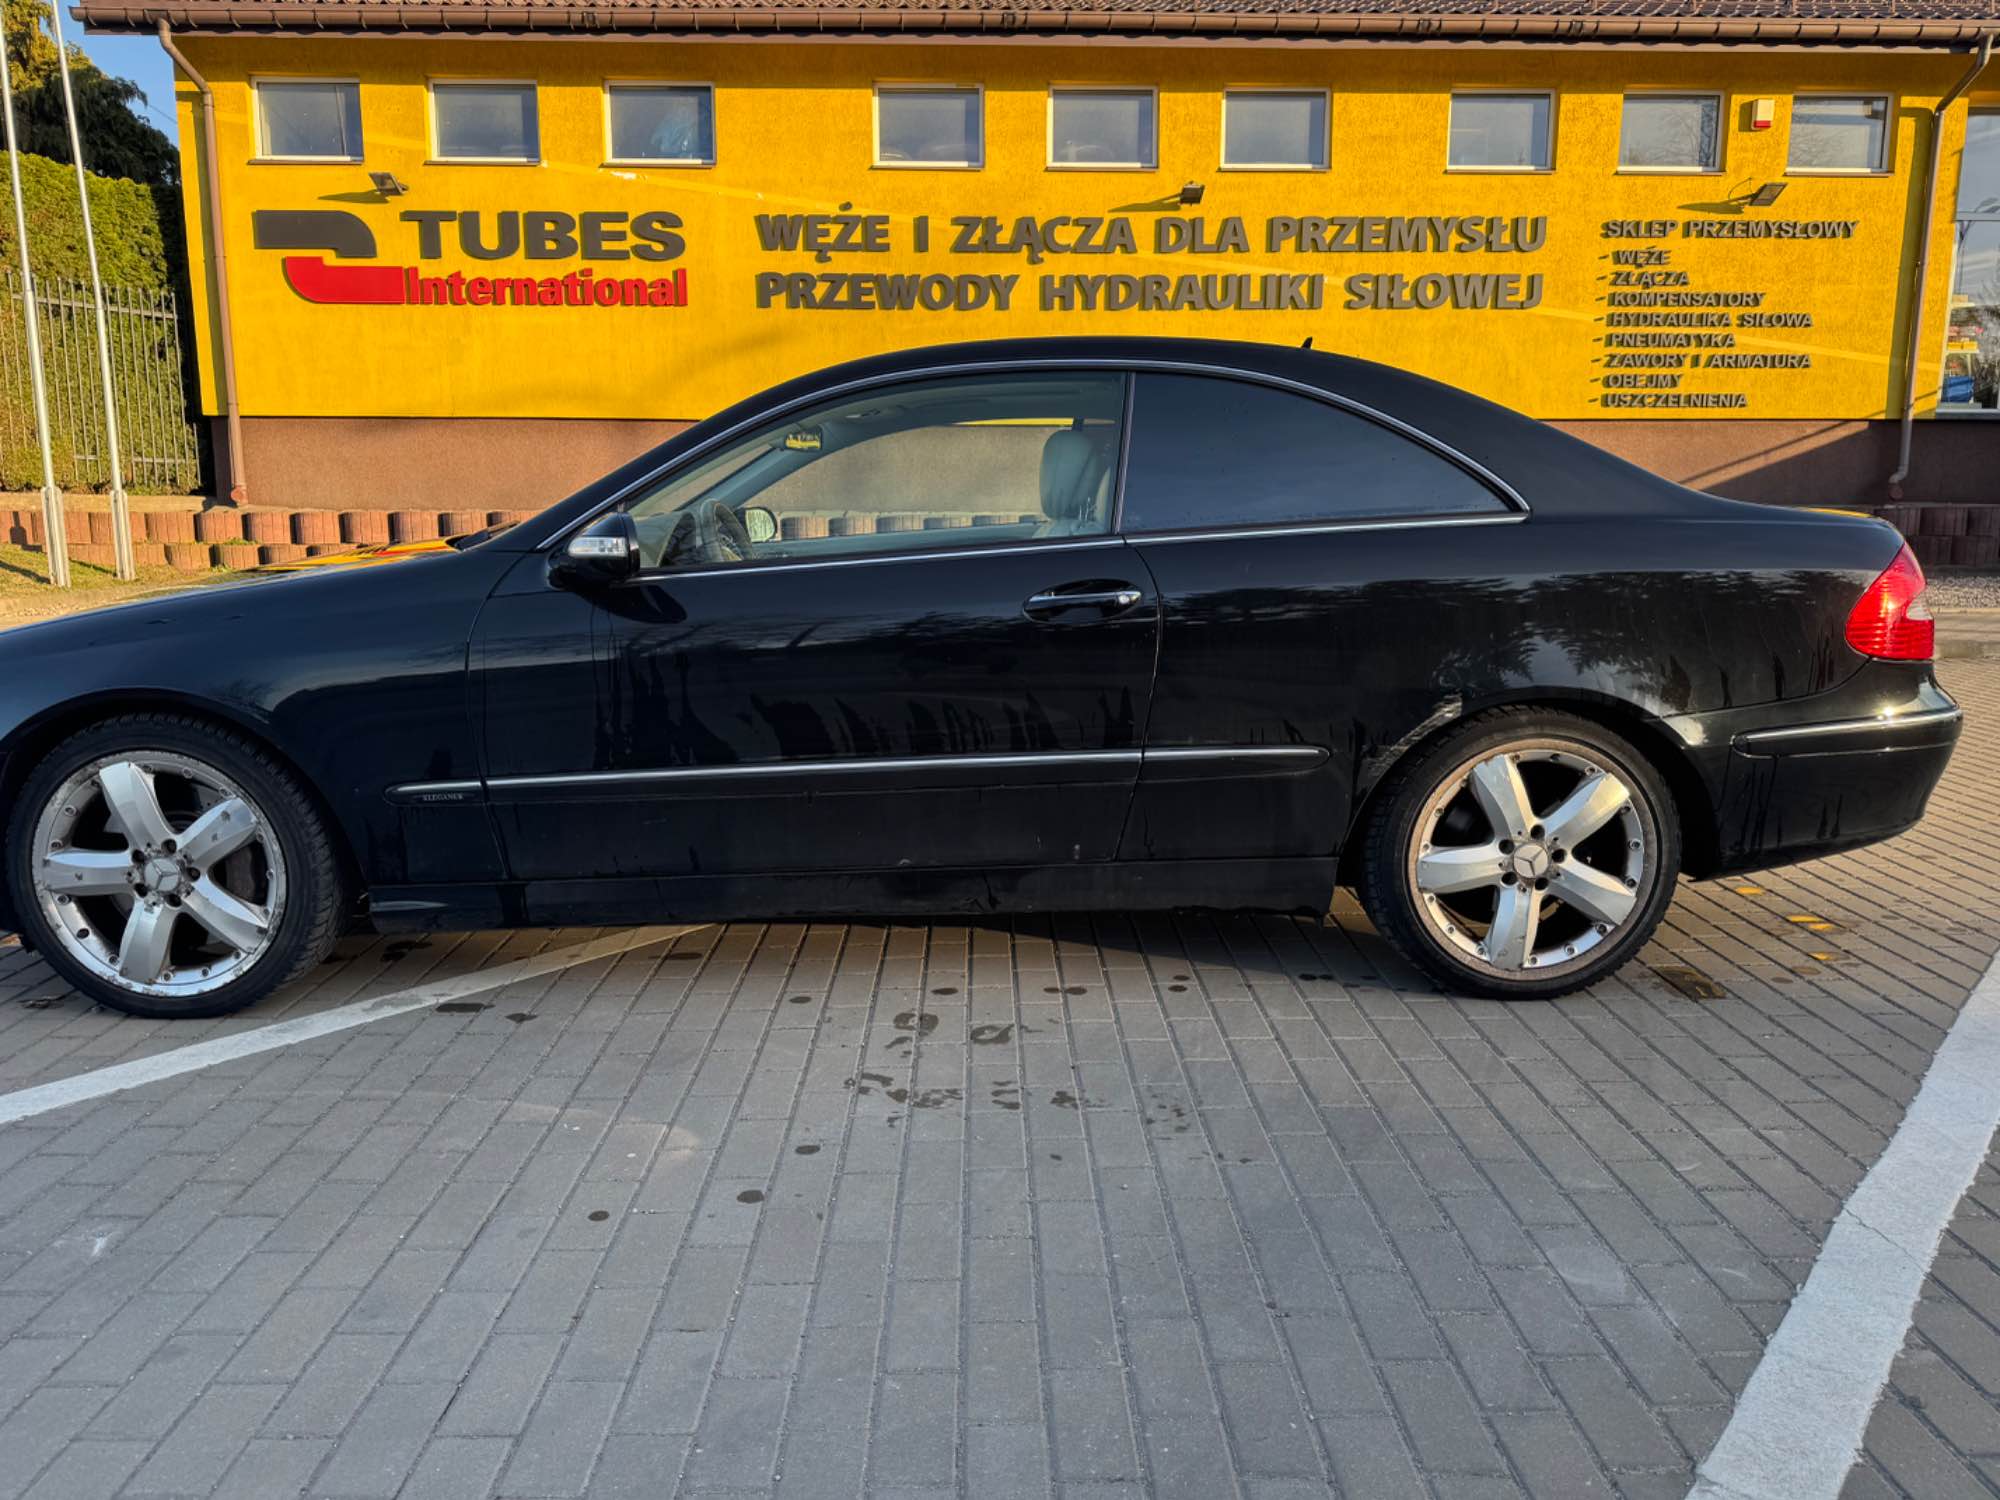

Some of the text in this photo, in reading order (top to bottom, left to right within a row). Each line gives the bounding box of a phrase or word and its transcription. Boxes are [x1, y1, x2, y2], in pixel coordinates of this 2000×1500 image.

[401, 210, 686, 261] TUBES
[754, 202, 1548, 265] WĘŻE I ZŁĄCZA DLA PRZEMYSŁU
[1600, 220, 1860, 239] SKLEP PRZEMYSŁOWY
[1612, 246, 1672, 269] WĘŻE
[402, 267, 688, 306] International
[755, 272, 1544, 312] PRZEWODY HYDRAULIKI SIŁOWEJ
[1608, 292, 1766, 306] KOMPENSATORY
[1606, 312, 1813, 328] HYDRAULIKA SIŁOWA
[1604, 333, 1735, 347] PNEUMATYKA
[1603, 354, 1811, 368] ZAWORY I ARMATURA
[1602, 374, 1683, 388] OBEJMY
[1600, 393, 1747, 408] USZCZELNIENIA
